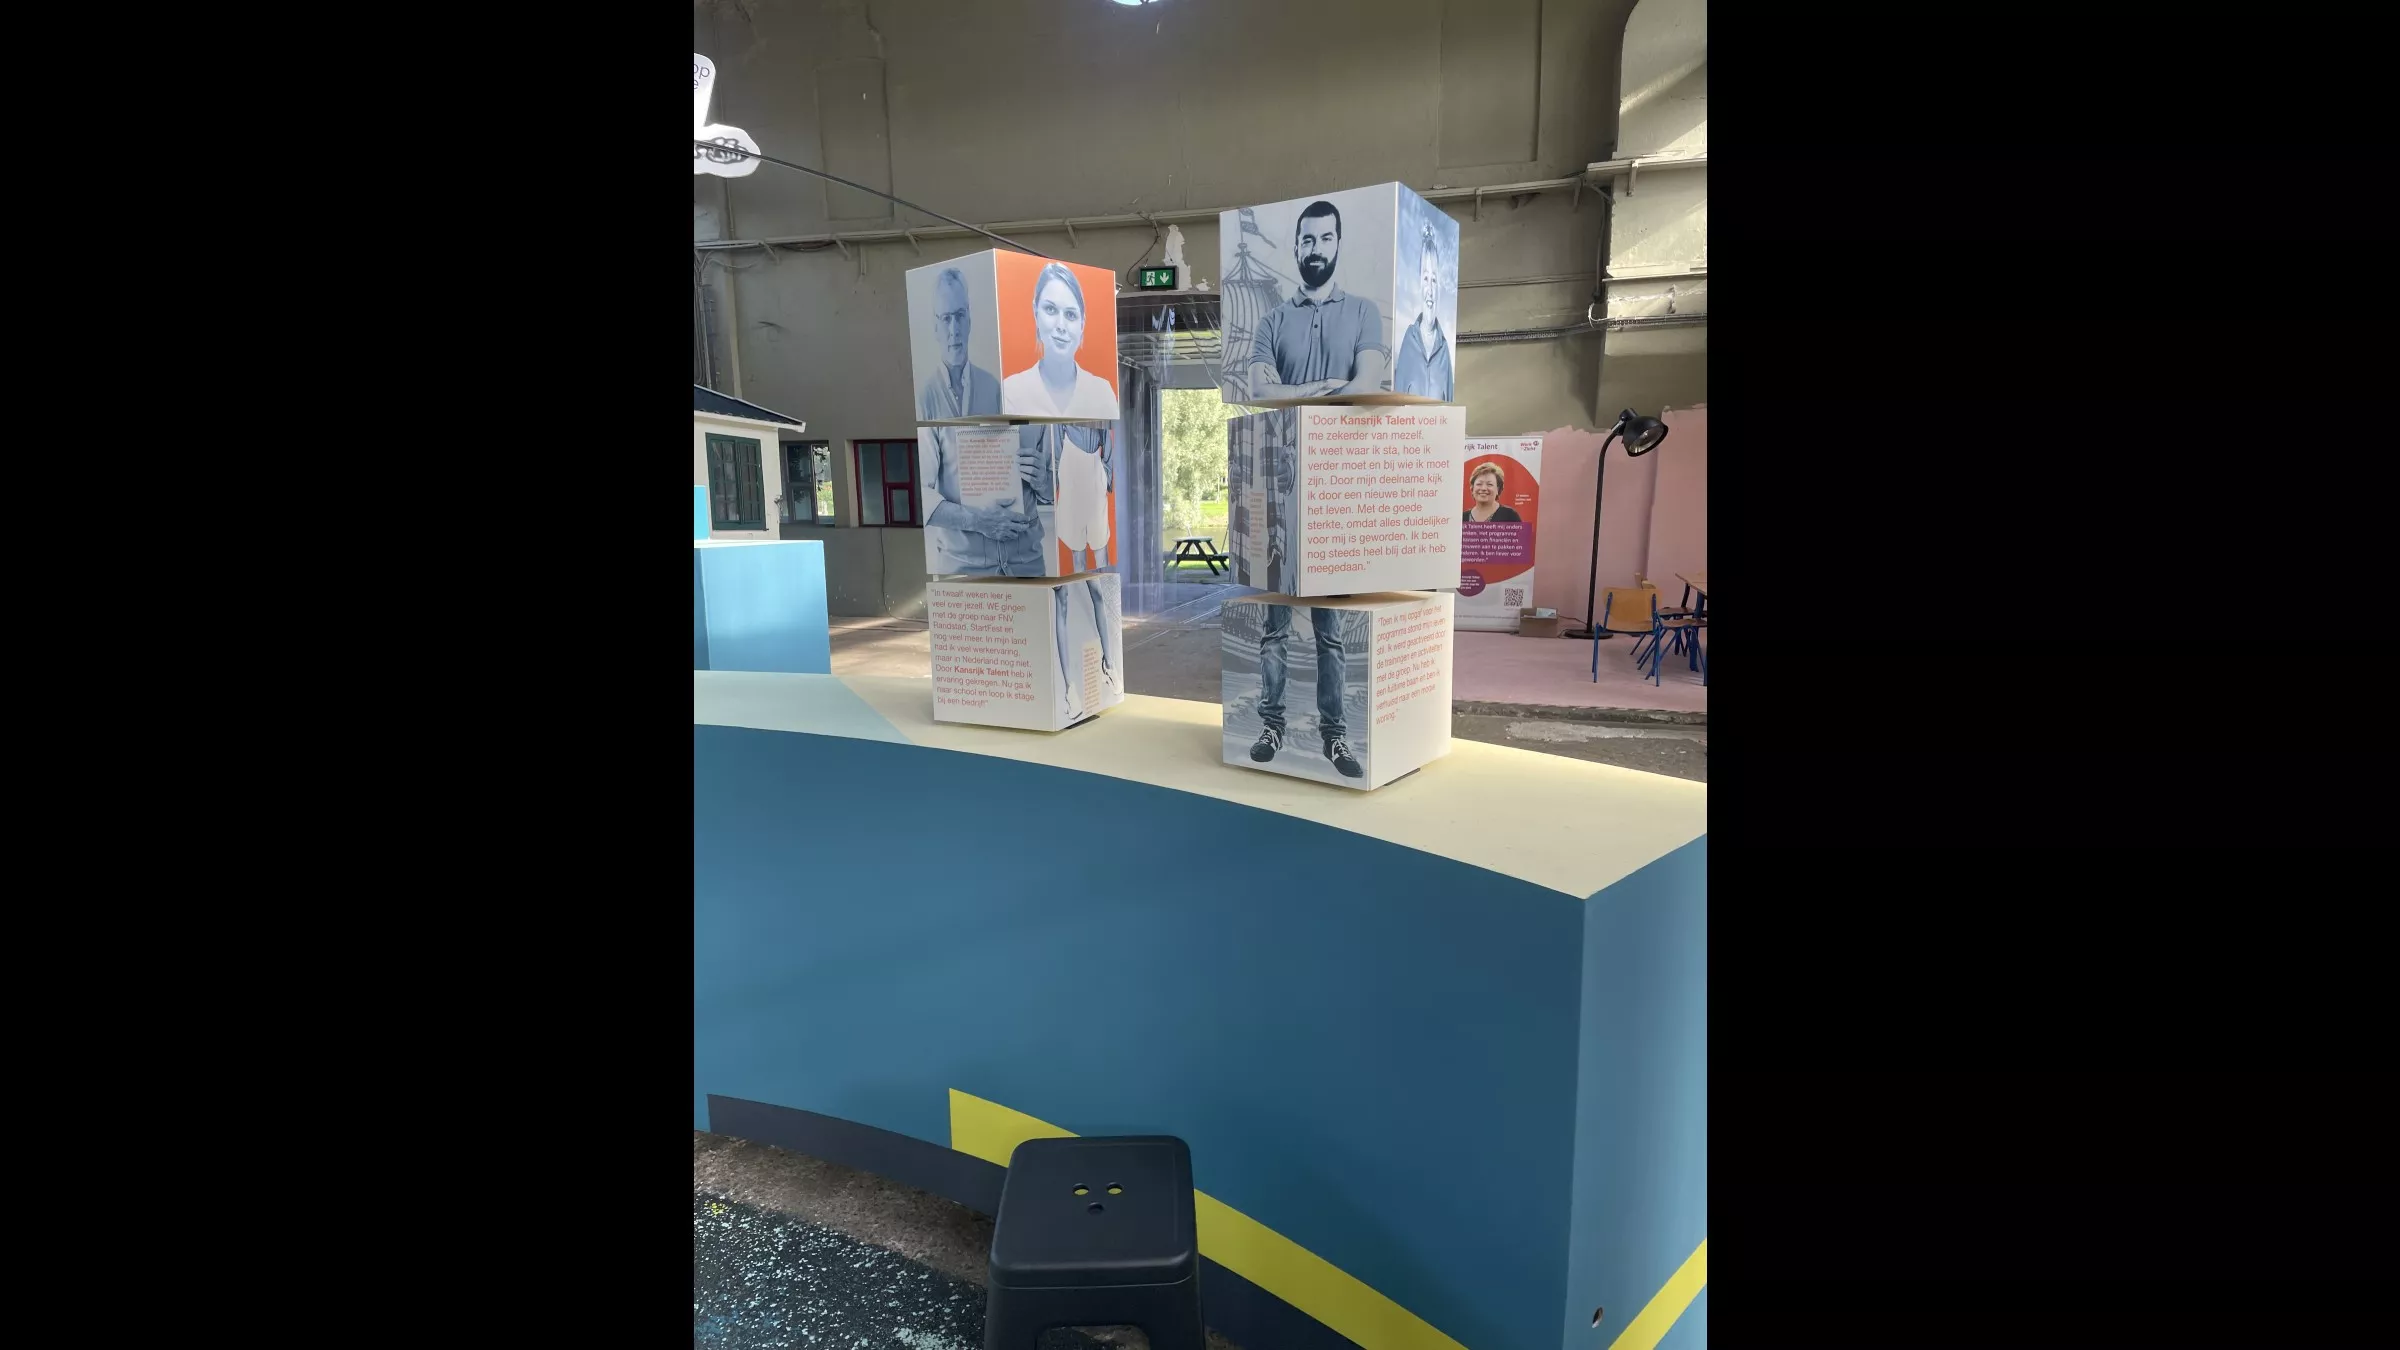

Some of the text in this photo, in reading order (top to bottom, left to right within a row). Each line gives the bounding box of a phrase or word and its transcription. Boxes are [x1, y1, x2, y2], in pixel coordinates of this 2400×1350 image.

[1340, 415, 1382, 427] Kansrijk
[1386, 416, 1415, 425] Talent
[1418, 416, 1437, 425] voel
[1439, 416, 1447, 424] ik
[1308, 430, 1424, 440] me zekerder van mezelf.
[1308, 445, 1431, 456] Ik weet waar ik sta, hoe ik
[1308, 460, 1449, 471] verder moet en bij wie ik moet
[1308, 474, 1442, 487] zijn. Door mijn deelname kijk
[1308, 488, 1438, 500] ik door een nieuwe bril naar
[1308, 503, 1422, 515] het leven. Met de goede
[1308, 516, 1449, 530] sterkte, omdat alles duidelijker
[1308, 531, 1439, 545] voor mij is geworden. Ik ben
[1308, 544, 1446, 560] nog steeds heel blij dat ik heb
[1005, 593, 1011, 601] je
[1001, 603, 1026, 613] gingen
[934, 632, 947, 641] nog
[995, 637, 1010, 645] mijn
[1012, 637, 1027, 645] land
[963, 656, 998, 665] Nederland
[936, 664, 953, 672] Door
[955, 666, 984, 676] Kansrijk
[986, 668, 1008, 676] Talent
[936, 676, 963, 685] ervaring
[1002, 680, 1012, 688] Nu
[954, 687, 976, 695] school
[989, 690, 1005, 699] loop
[1015, 693, 1034, 702] stage
